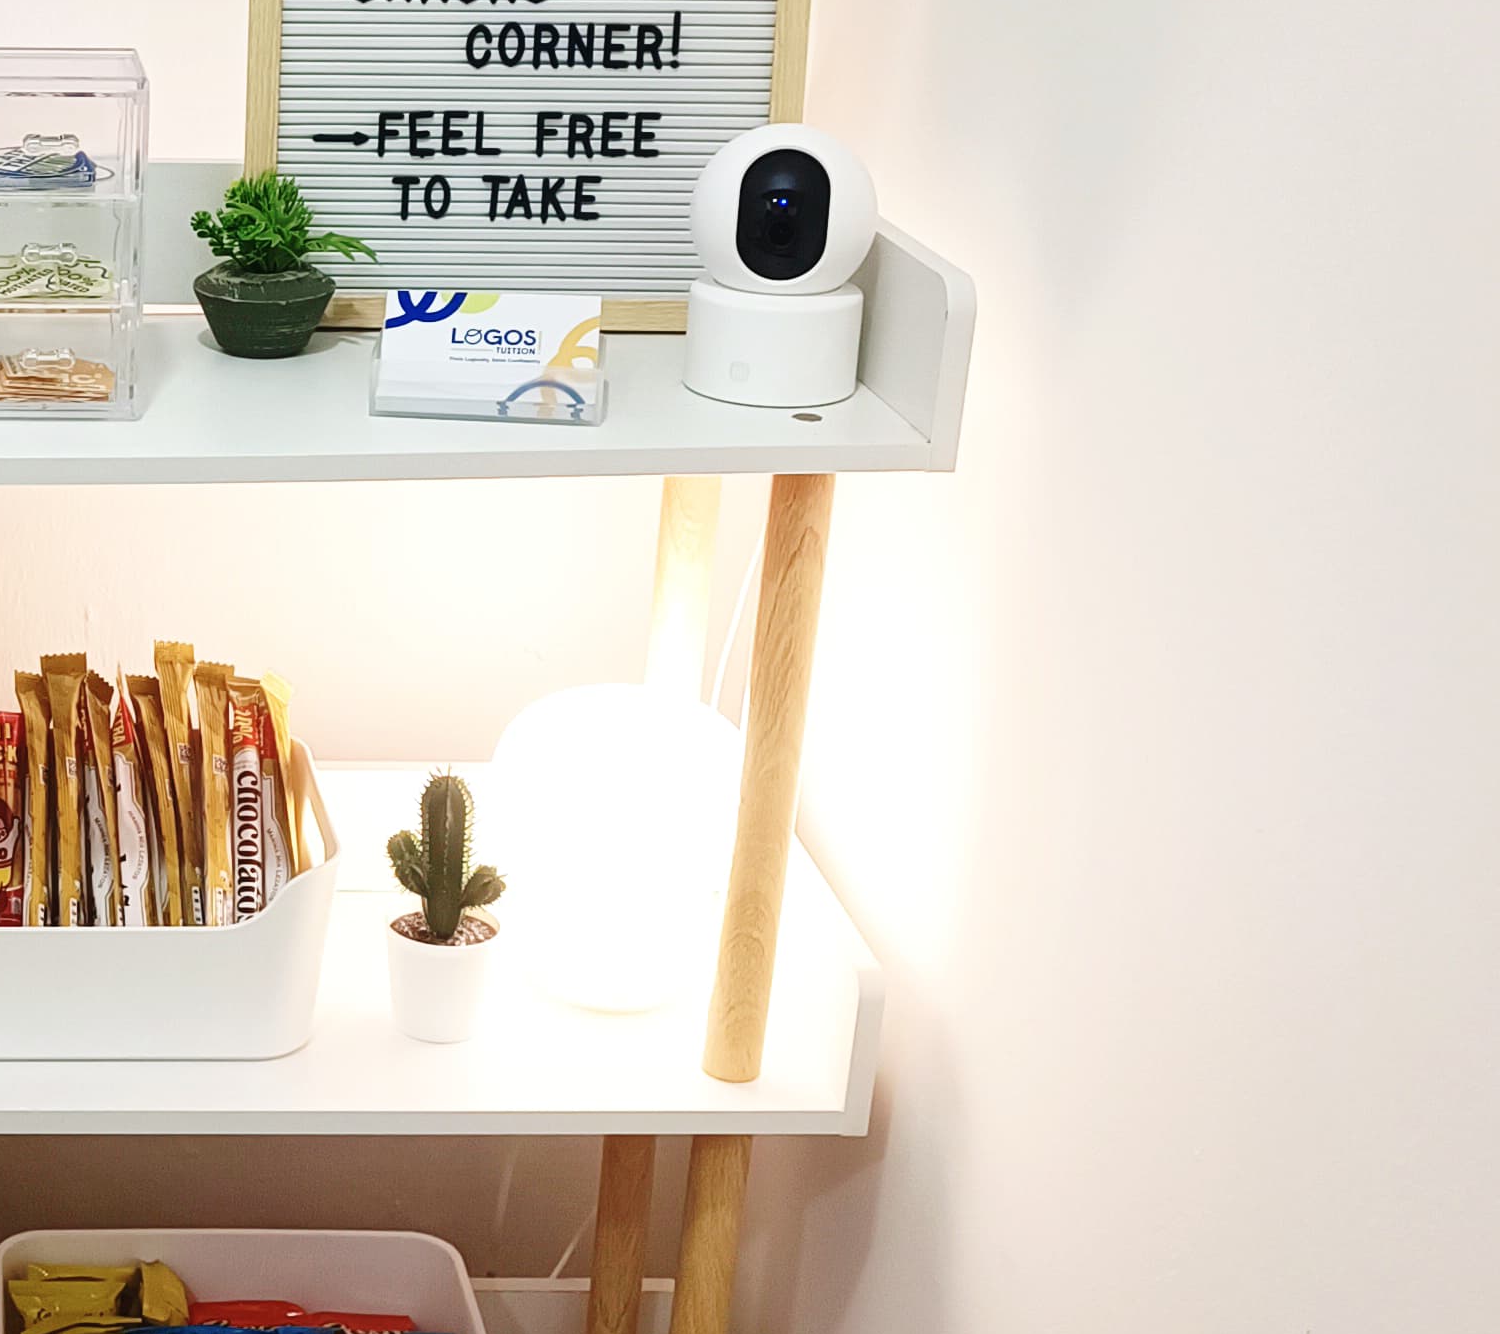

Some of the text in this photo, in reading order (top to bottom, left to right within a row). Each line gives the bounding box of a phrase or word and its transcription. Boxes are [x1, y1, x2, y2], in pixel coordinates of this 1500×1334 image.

[465, 10, 682, 70] CORNER!
[377, 111, 662, 159] FEEL FREE
[391, 174, 603, 224] TO TAKE
[451, 327, 537, 346] LOGOS
[496, 347, 536, 355] TUITION
